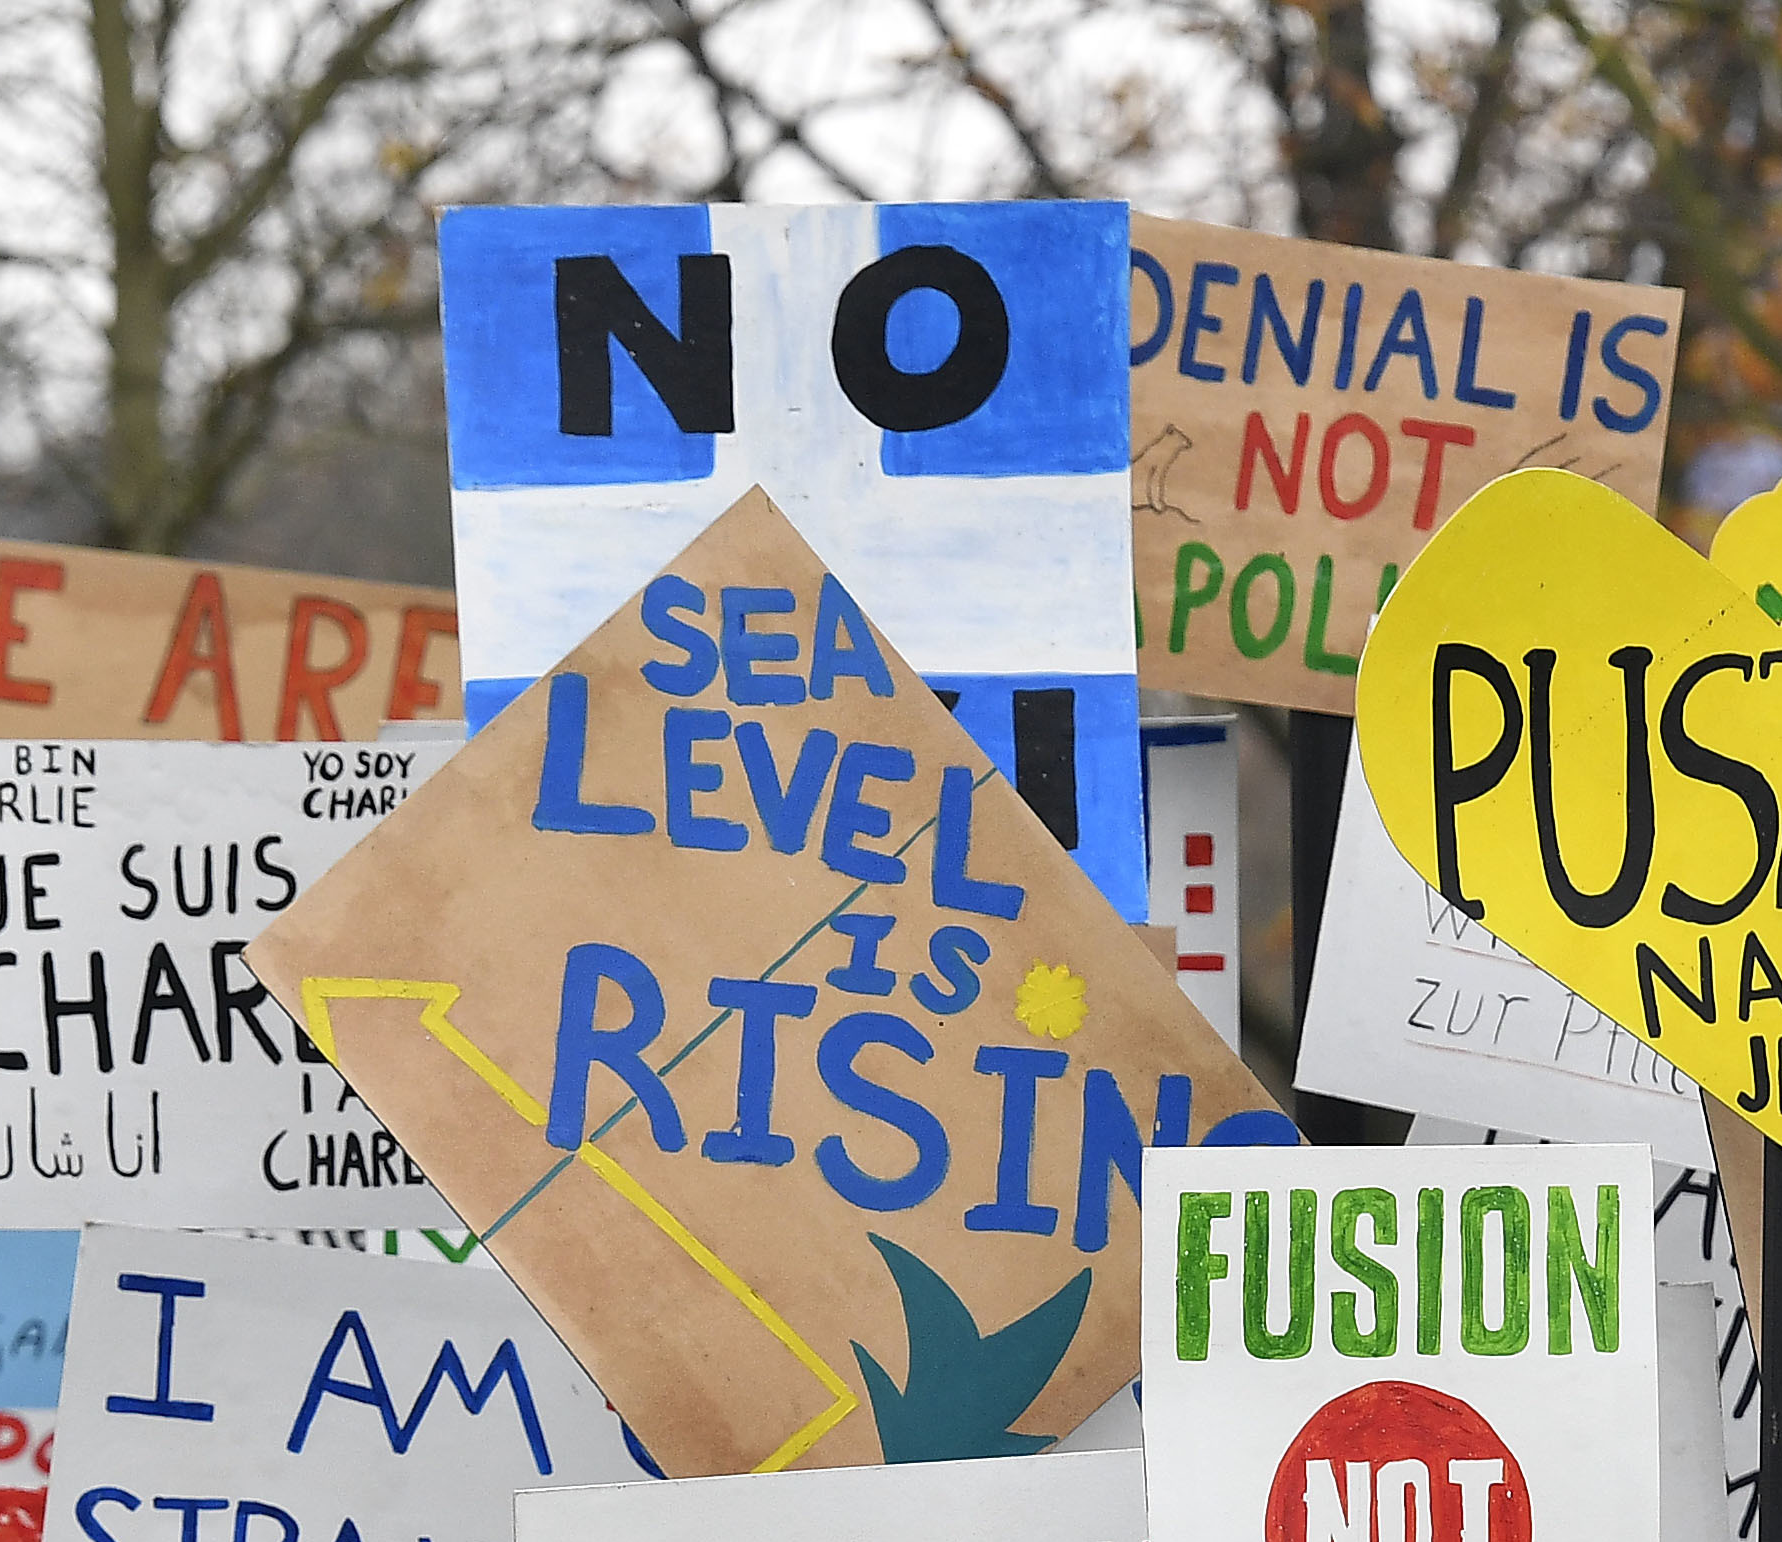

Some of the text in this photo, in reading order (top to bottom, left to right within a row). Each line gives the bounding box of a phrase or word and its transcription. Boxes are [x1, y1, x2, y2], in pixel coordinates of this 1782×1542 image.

[554, 245, 1010, 437] NO
[1130, 248, 1669, 434] DENIAL IS
[1235, 411, 1477, 532] NOT
[639, 572, 894, 707] SEA
[15, 745, 97, 777] BIN
[303, 749, 416, 782] YO SOY
[532, 672, 1025, 922] LEVEL
[119, 834, 298, 921] SUIS
[826, 912, 991, 1014] IS
[1175, 1183, 1622, 1363] FUSION
[104, 1271, 554, 1476] I AM
